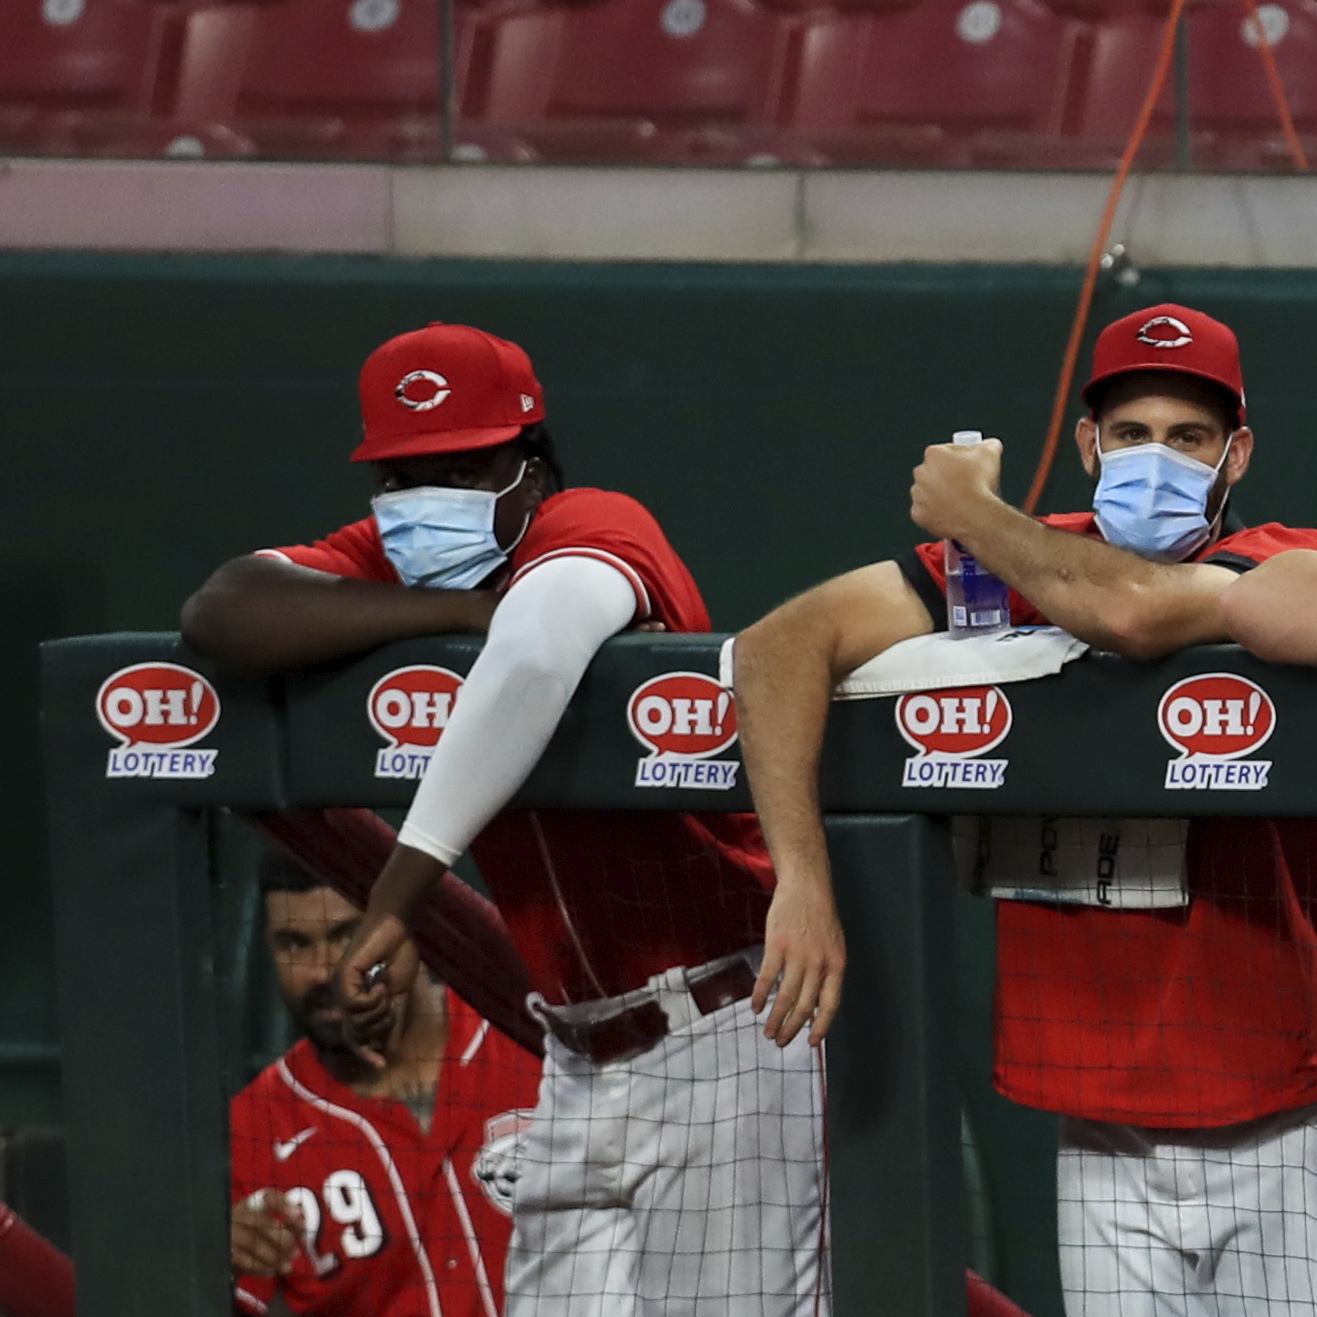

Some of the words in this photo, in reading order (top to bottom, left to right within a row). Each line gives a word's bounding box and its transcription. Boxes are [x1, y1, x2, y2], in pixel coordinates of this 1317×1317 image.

[106, 681, 204, 727] OH!
[376, 687, 463, 728] OH
[637, 692, 730, 736] OH!
[905, 690, 998, 735] OH!
[1167, 691, 1261, 737] OH!
[111, 752, 211, 773] LOTTERY
[380, 754, 432, 773] LOTT
[640, 763, 733, 784] LOTTERY
[907, 762, 1001, 782] LOTTERY
[1170, 764, 1265, 784] LOTTERY
